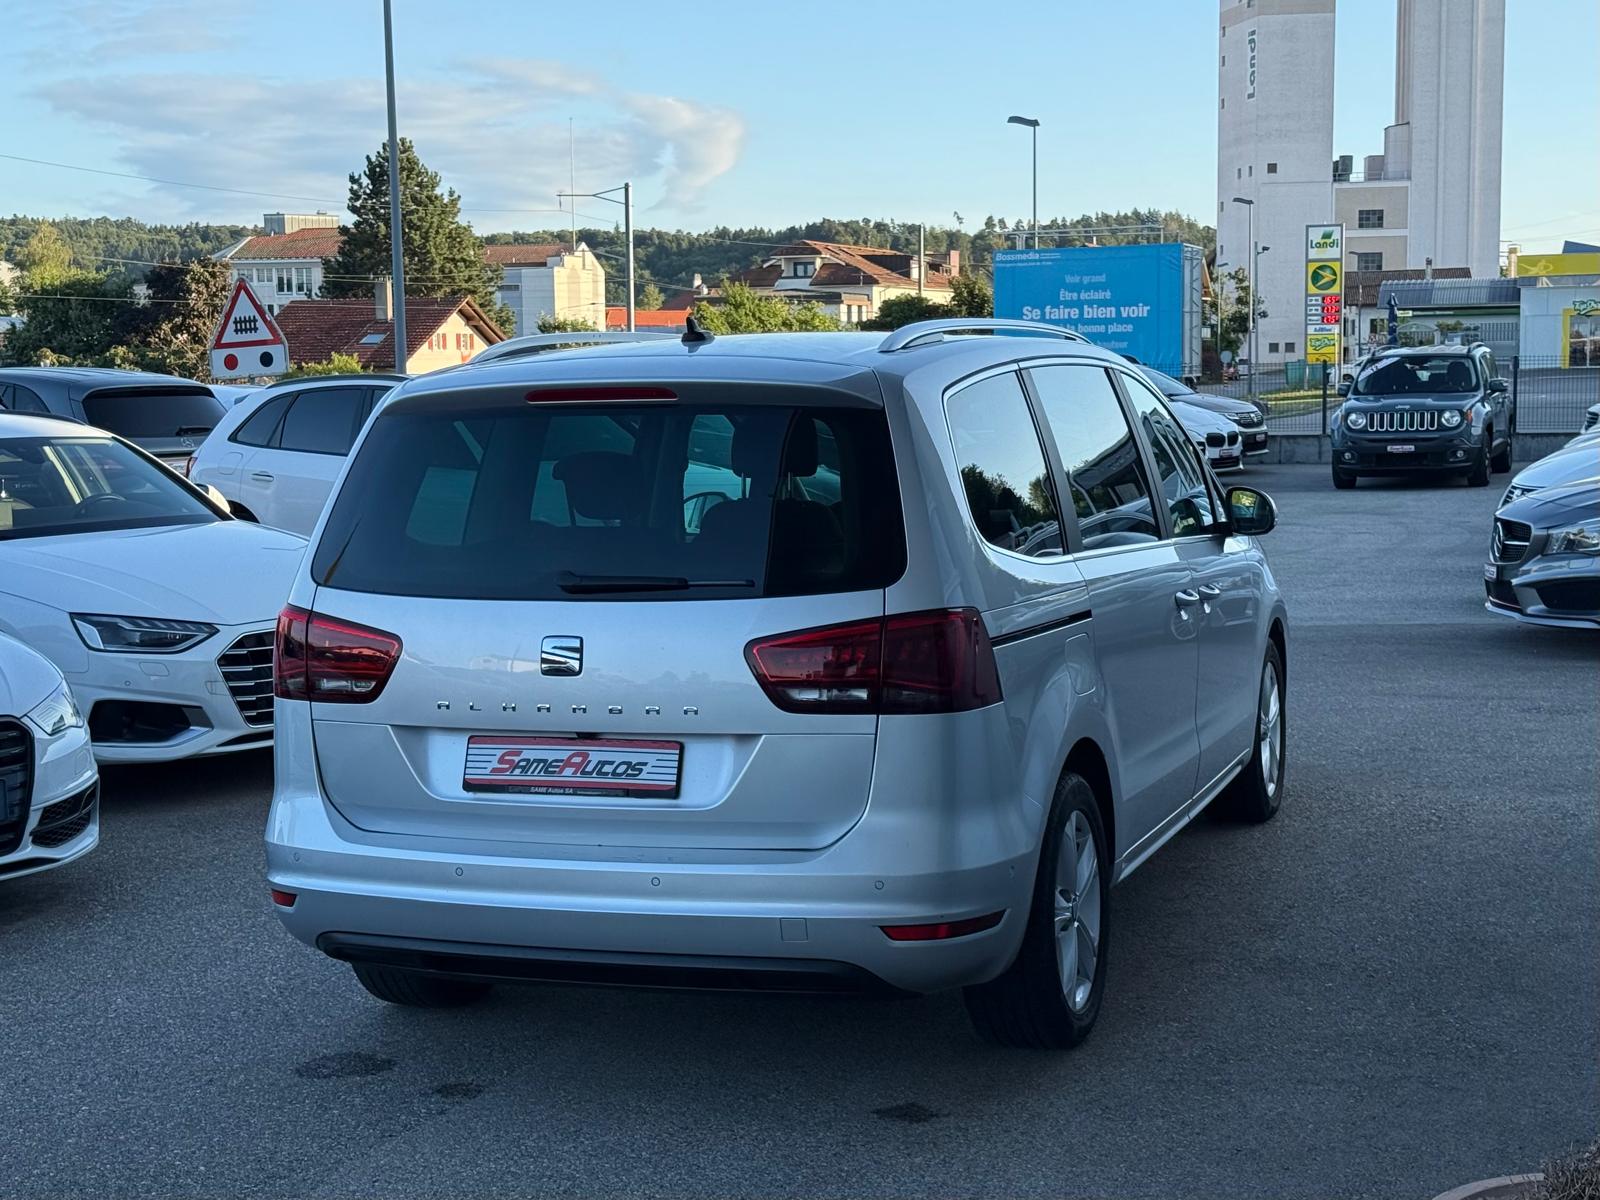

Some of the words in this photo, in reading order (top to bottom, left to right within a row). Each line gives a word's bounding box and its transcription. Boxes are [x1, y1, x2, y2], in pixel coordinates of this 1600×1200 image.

[1247, 29, 1257, 100] Landi
[1310, 238, 1339, 249] Landi
[995, 252, 1040, 261] Bossmedia
[1065, 274, 1081, 283] Voir
[1082, 274, 1106, 284] grand
[1059, 289, 1078, 301] Être
[1080, 289, 1111, 300] éclairé
[1022, 306, 1041, 320] Se
[1044, 305, 1079, 319] faire
[1083, 304, 1116, 318] bien
[1120, 303, 1150, 317] voir
[1078, 323, 1105, 333] bonne
[1107, 322, 1133, 334] place
[437, 701, 699, 715] ALHAMBRA
